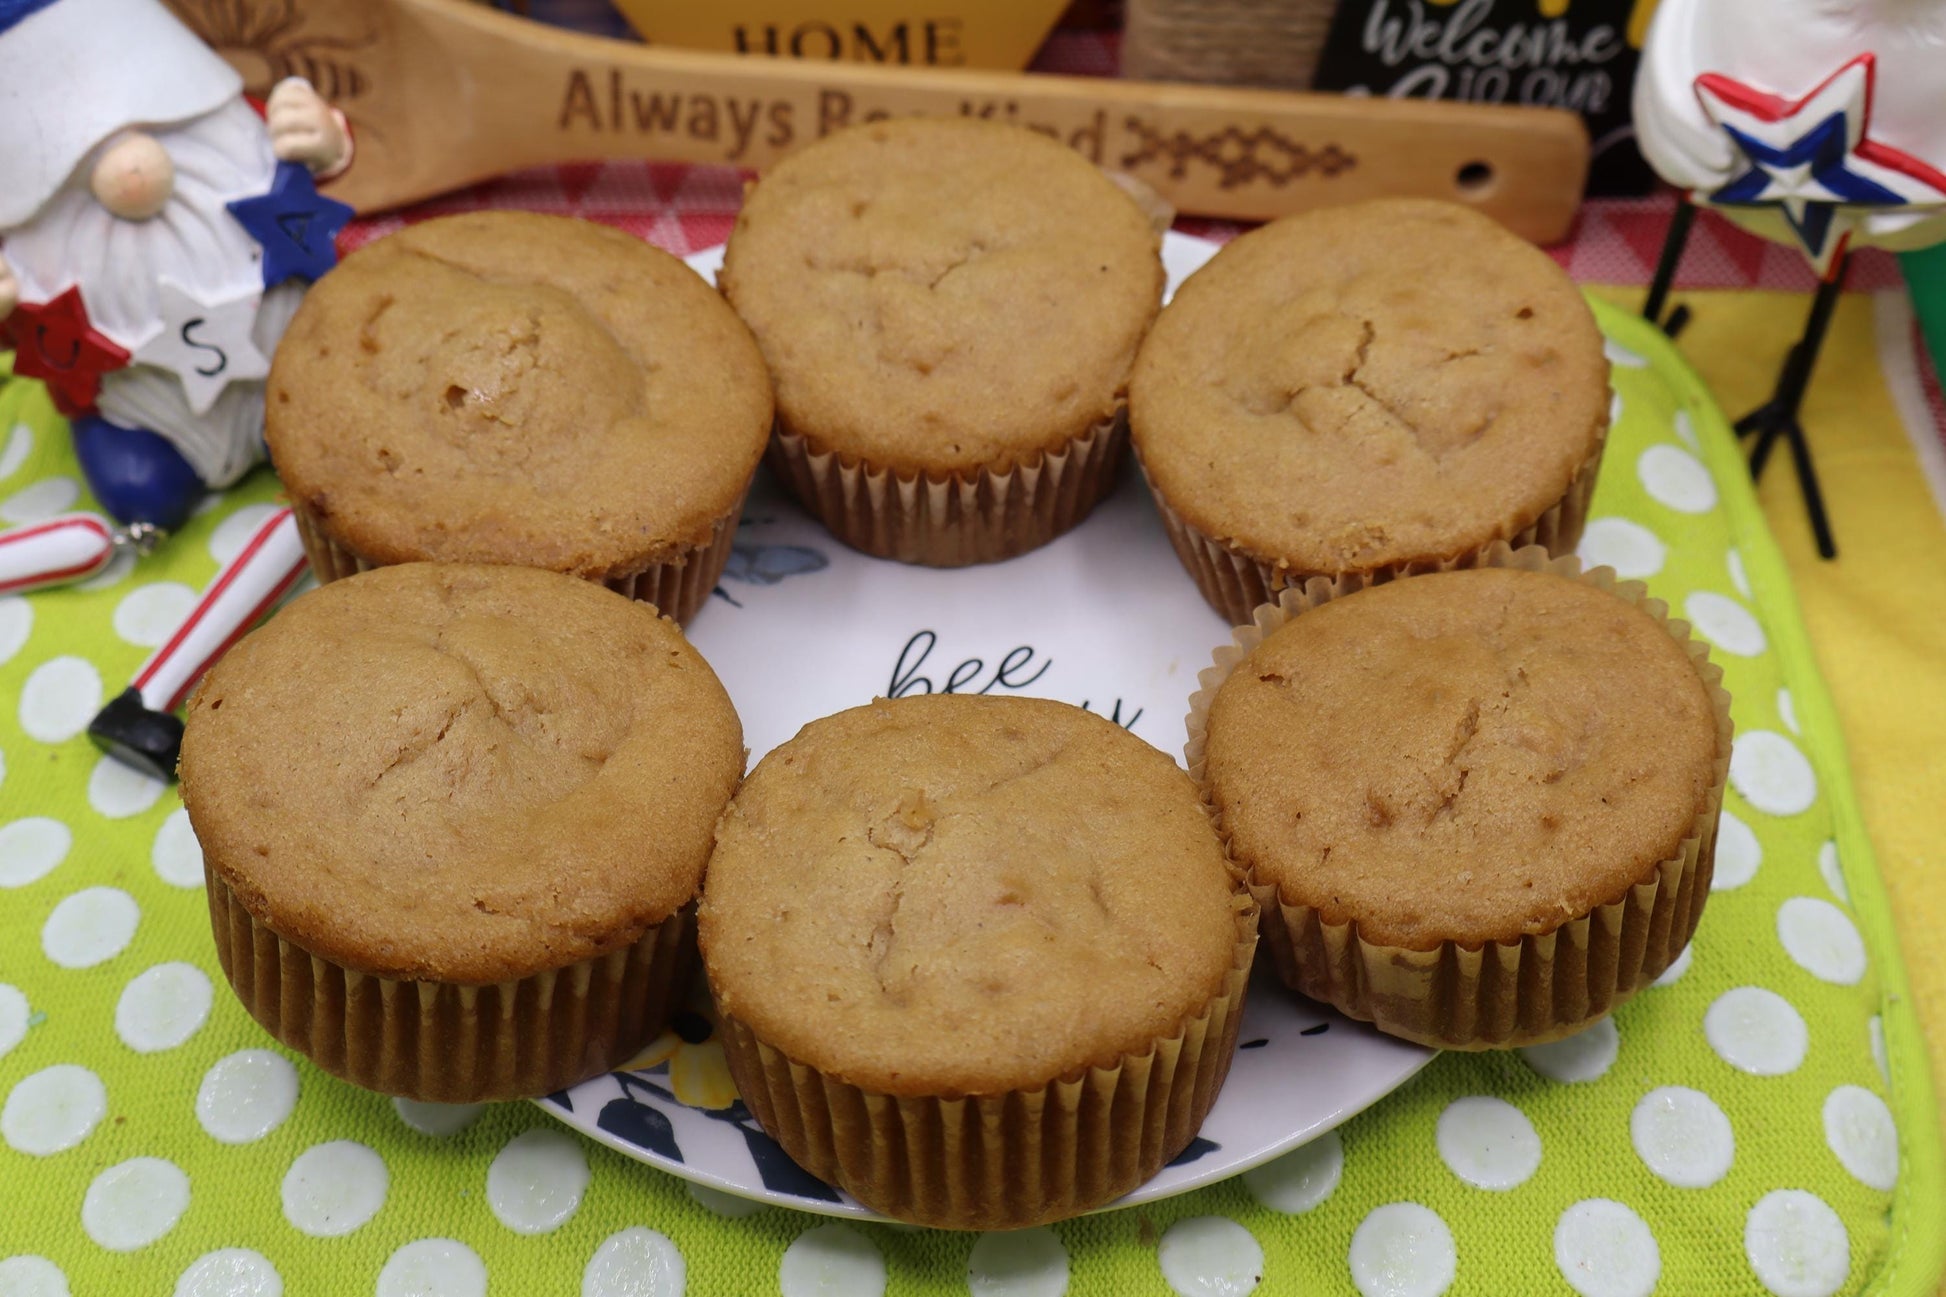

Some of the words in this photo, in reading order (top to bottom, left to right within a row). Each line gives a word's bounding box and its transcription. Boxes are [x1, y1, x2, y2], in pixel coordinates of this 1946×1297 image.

[732, 19, 967, 65] HOME
[1361, 0, 1623, 67] Welcome
[558, 68, 795, 160] Always
[181, 316, 228, 377] S
